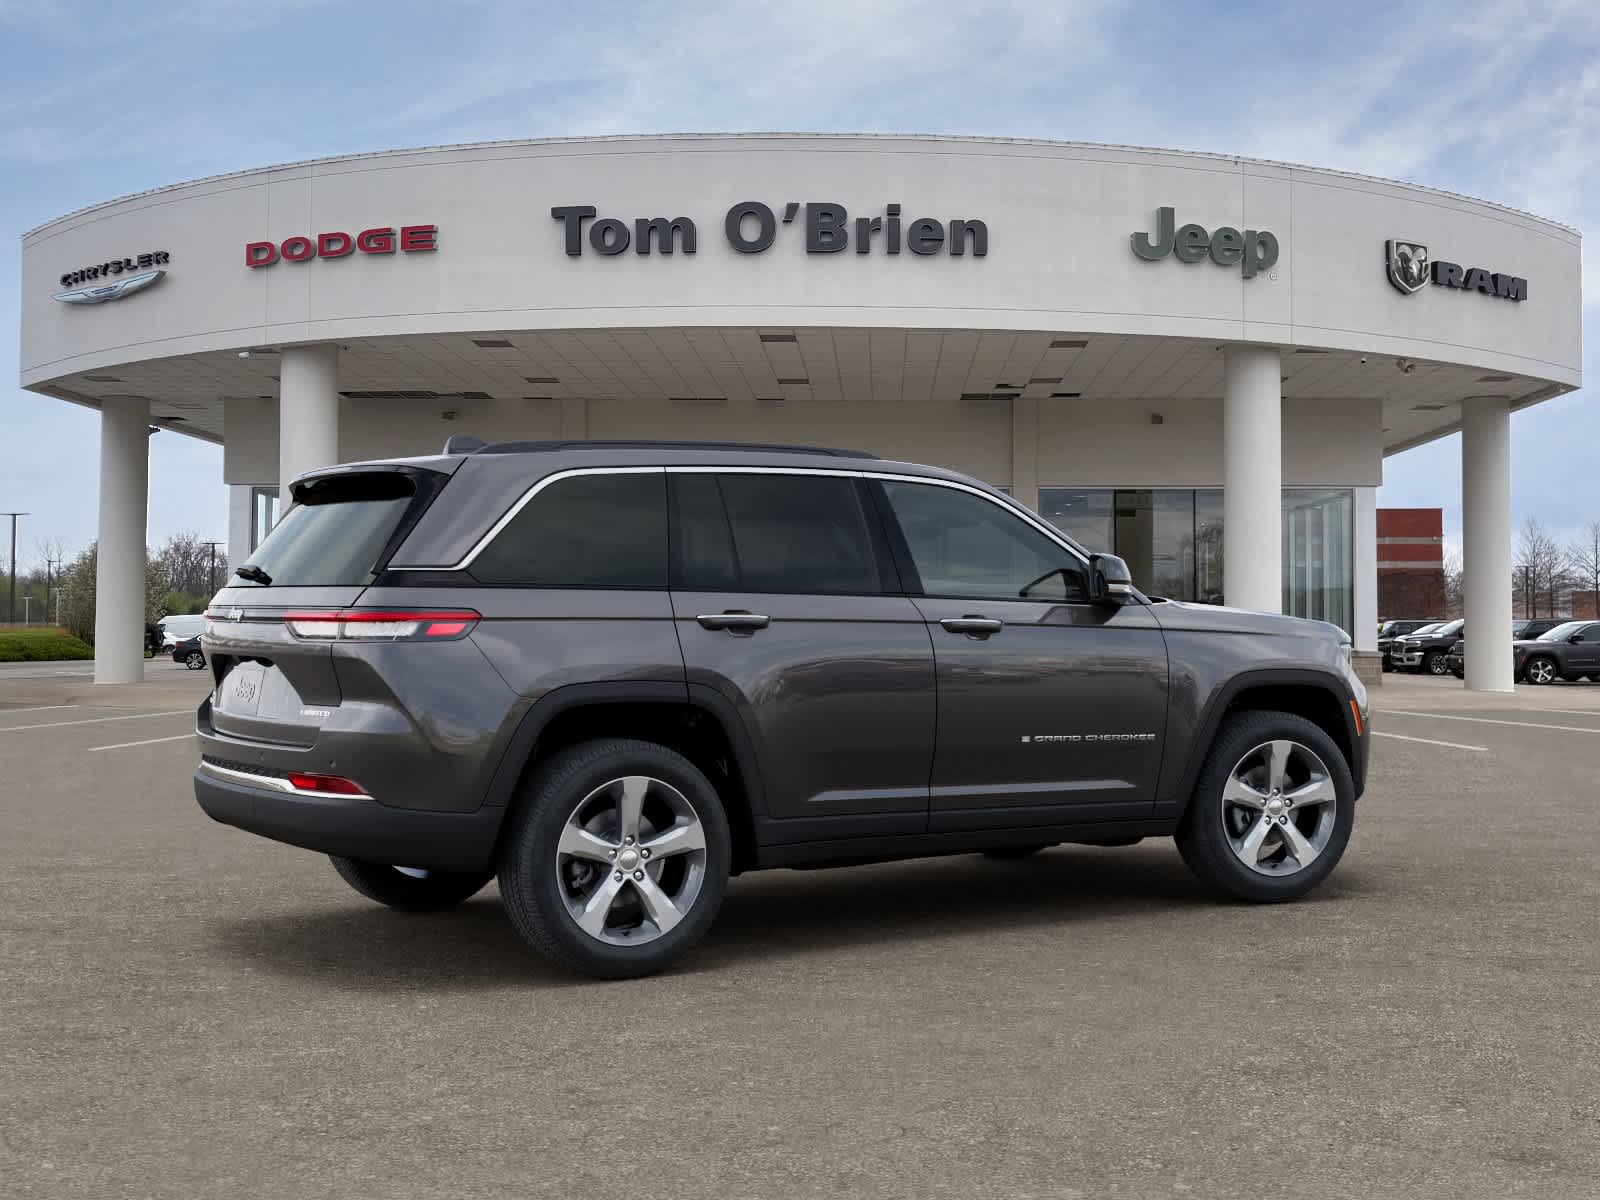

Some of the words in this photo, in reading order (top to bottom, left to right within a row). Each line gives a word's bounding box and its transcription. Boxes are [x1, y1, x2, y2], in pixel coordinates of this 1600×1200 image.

[245, 224, 439, 268] DODGE
[551, 205, 697, 256] Tom
[725, 201, 988, 257] O'Brien
[1130, 206, 1279, 279] Jeep
[60, 250, 170, 287] CHRYSLER
[1430, 260, 1527, 302] RAM
[1085, 733, 1156, 741] CHEROKEE
